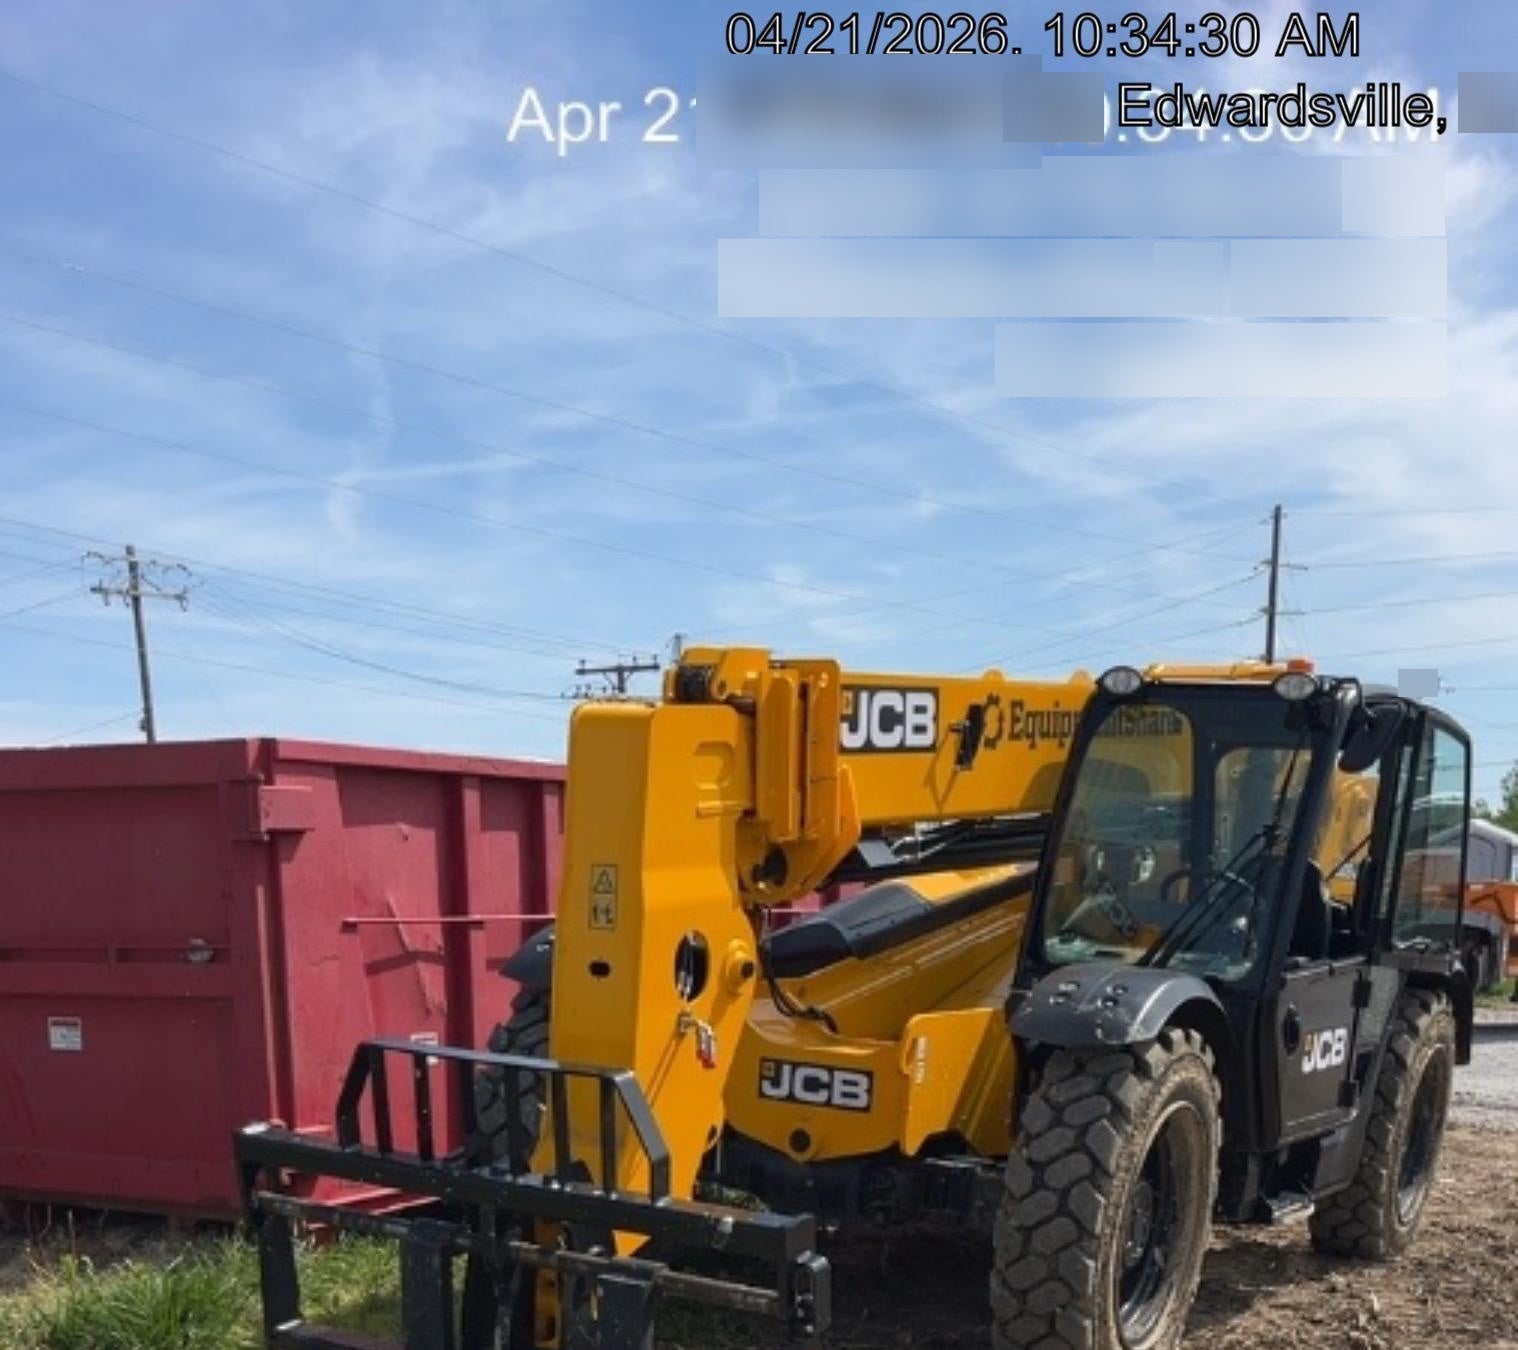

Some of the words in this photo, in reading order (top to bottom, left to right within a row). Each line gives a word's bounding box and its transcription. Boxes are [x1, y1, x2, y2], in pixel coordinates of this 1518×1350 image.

[840, 689, 937, 749] JCB
[1301, 1027, 1348, 1075] JCB
[760, 1062, 871, 1110] JCB
